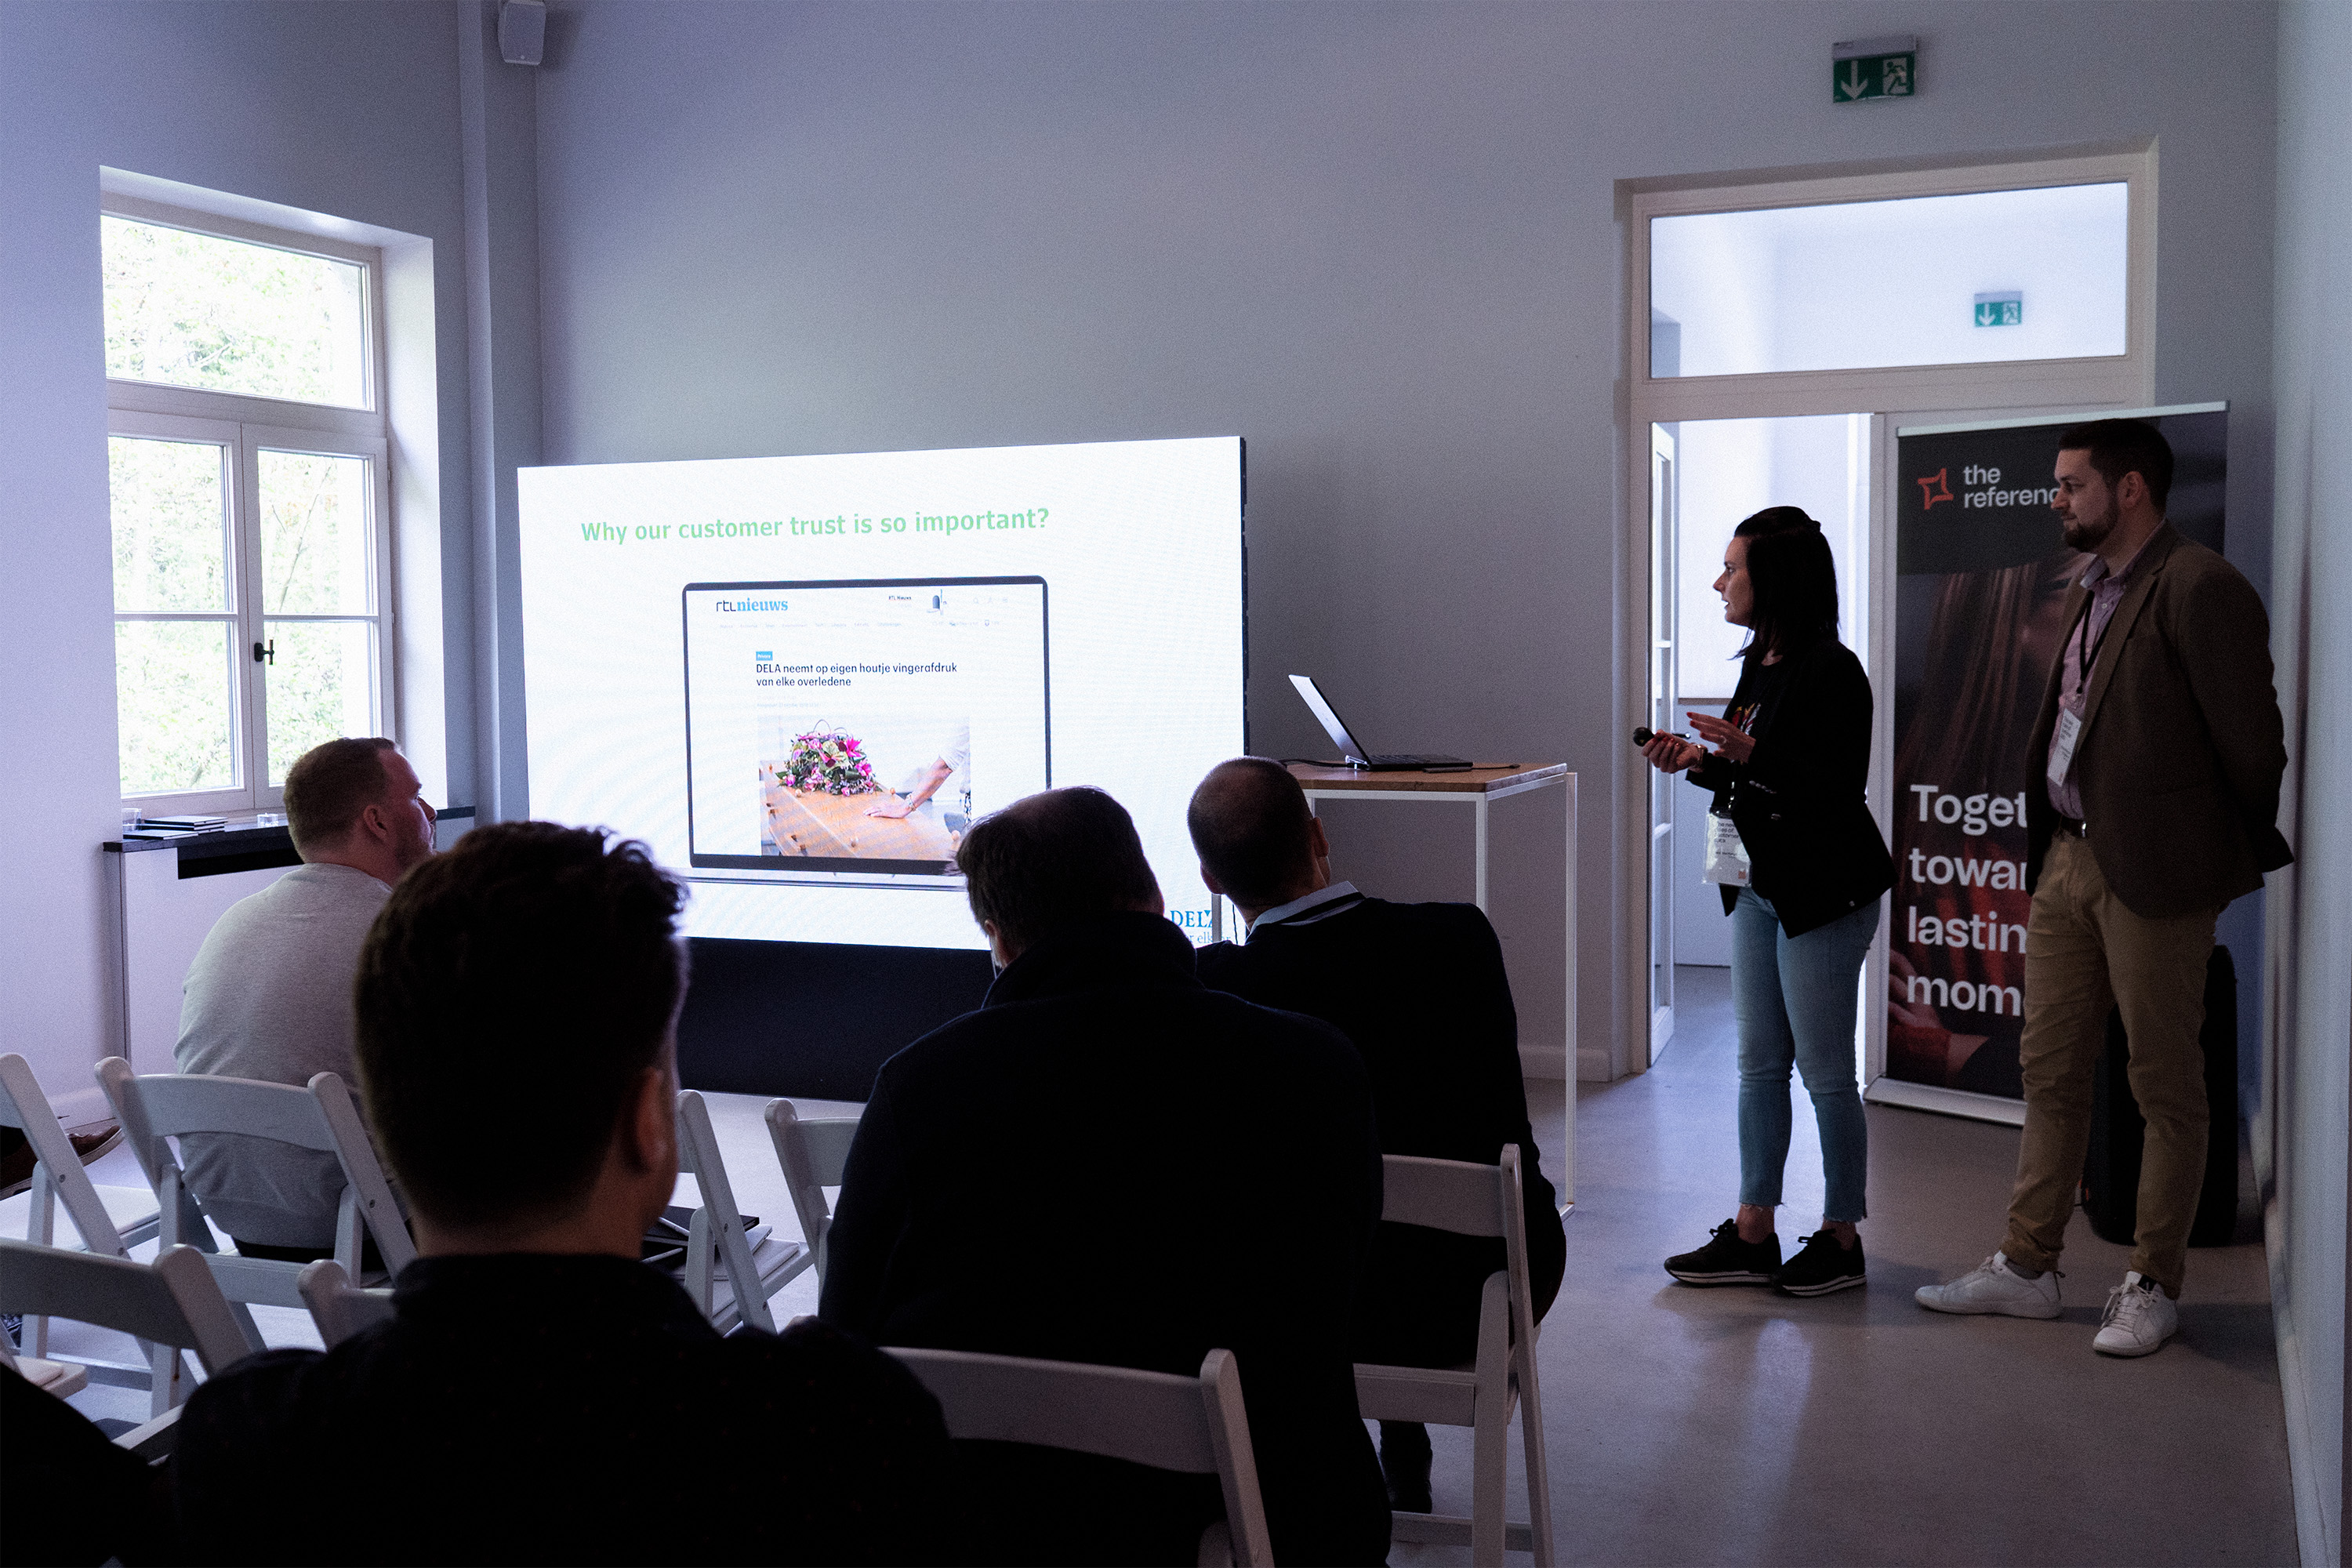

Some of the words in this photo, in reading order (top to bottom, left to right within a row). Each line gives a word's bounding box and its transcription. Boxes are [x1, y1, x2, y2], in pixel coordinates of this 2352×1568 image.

[1962, 464, 2001, 485] the
[581, 521, 627, 545] Why
[635, 524, 671, 540] our
[678, 519, 782, 539] customer
[789, 515, 846, 536] trust
[854, 514, 873, 534] is
[880, 517, 906, 533] so
[916, 508, 1049, 536] important?
[756, 663, 782, 673] DELA
[783, 664, 813, 673] neemt
[815, 666, 828, 675] op
[830, 663, 857, 675] eigen
[859, 662, 891, 675] houtje
[893, 662, 957, 675] vingerafdruk
[776, 677, 795, 686] elke
[797, 677, 851, 686] overledene
[1910, 784, 2027, 836] Toget
[1908, 906, 2027, 954] lastin
[1907, 975, 2022, 1017] mom
